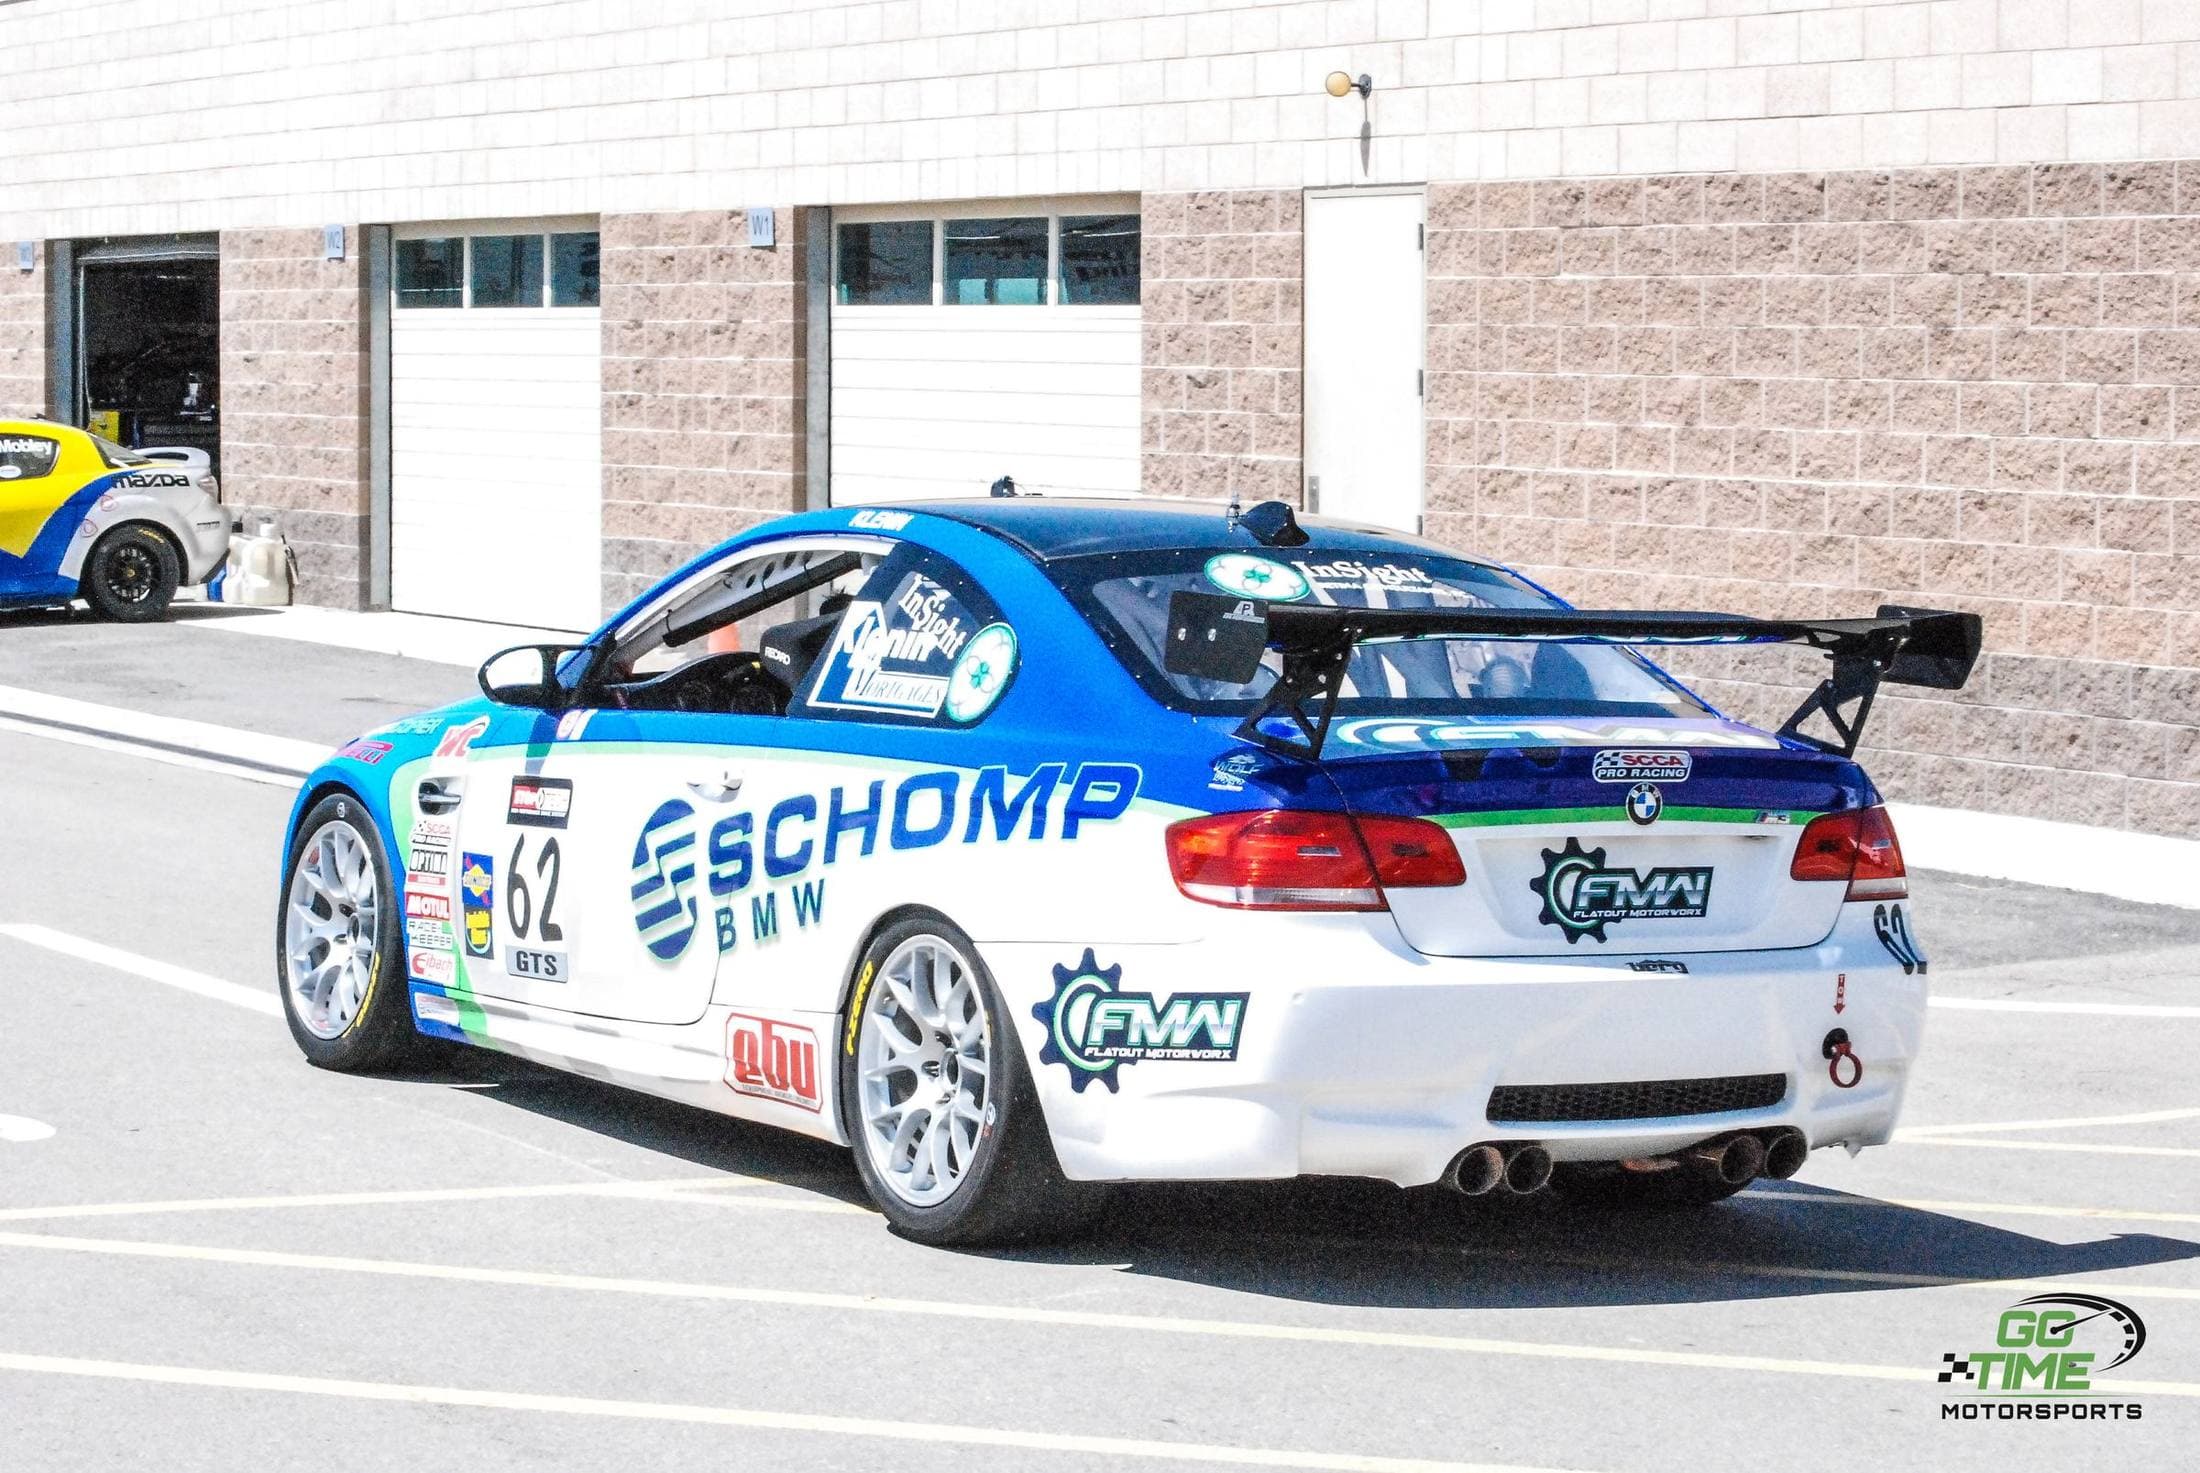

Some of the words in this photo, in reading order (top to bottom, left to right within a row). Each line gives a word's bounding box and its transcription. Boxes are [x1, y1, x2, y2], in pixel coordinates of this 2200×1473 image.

[752, 215, 769, 235] W1
[1291, 561, 1433, 585] InSight
[1597, 769, 1627, 778] PRO
[1630, 768, 1686, 777] RACING
[1620, 755, 1684, 766] SCCA
[708, 763, 1143, 897] SCHOMP
[410, 850, 448, 874] OPTIMA
[506, 833, 563, 942] 62
[1575, 873, 1709, 908] FMW
[407, 894, 450, 919] MOTUL
[715, 878, 826, 952] BMW
[1573, 910, 1628, 919] FLATOUT
[1629, 908, 1704, 918] MOTORWORX
[1874, 903, 1928, 976] 62
[516, 950, 558, 976] GTS
[1087, 999, 1242, 1047] FMW
[1084, 1047, 1144, 1057] FLATOUT
[1145, 1049, 1233, 1059] MOTORWORX
